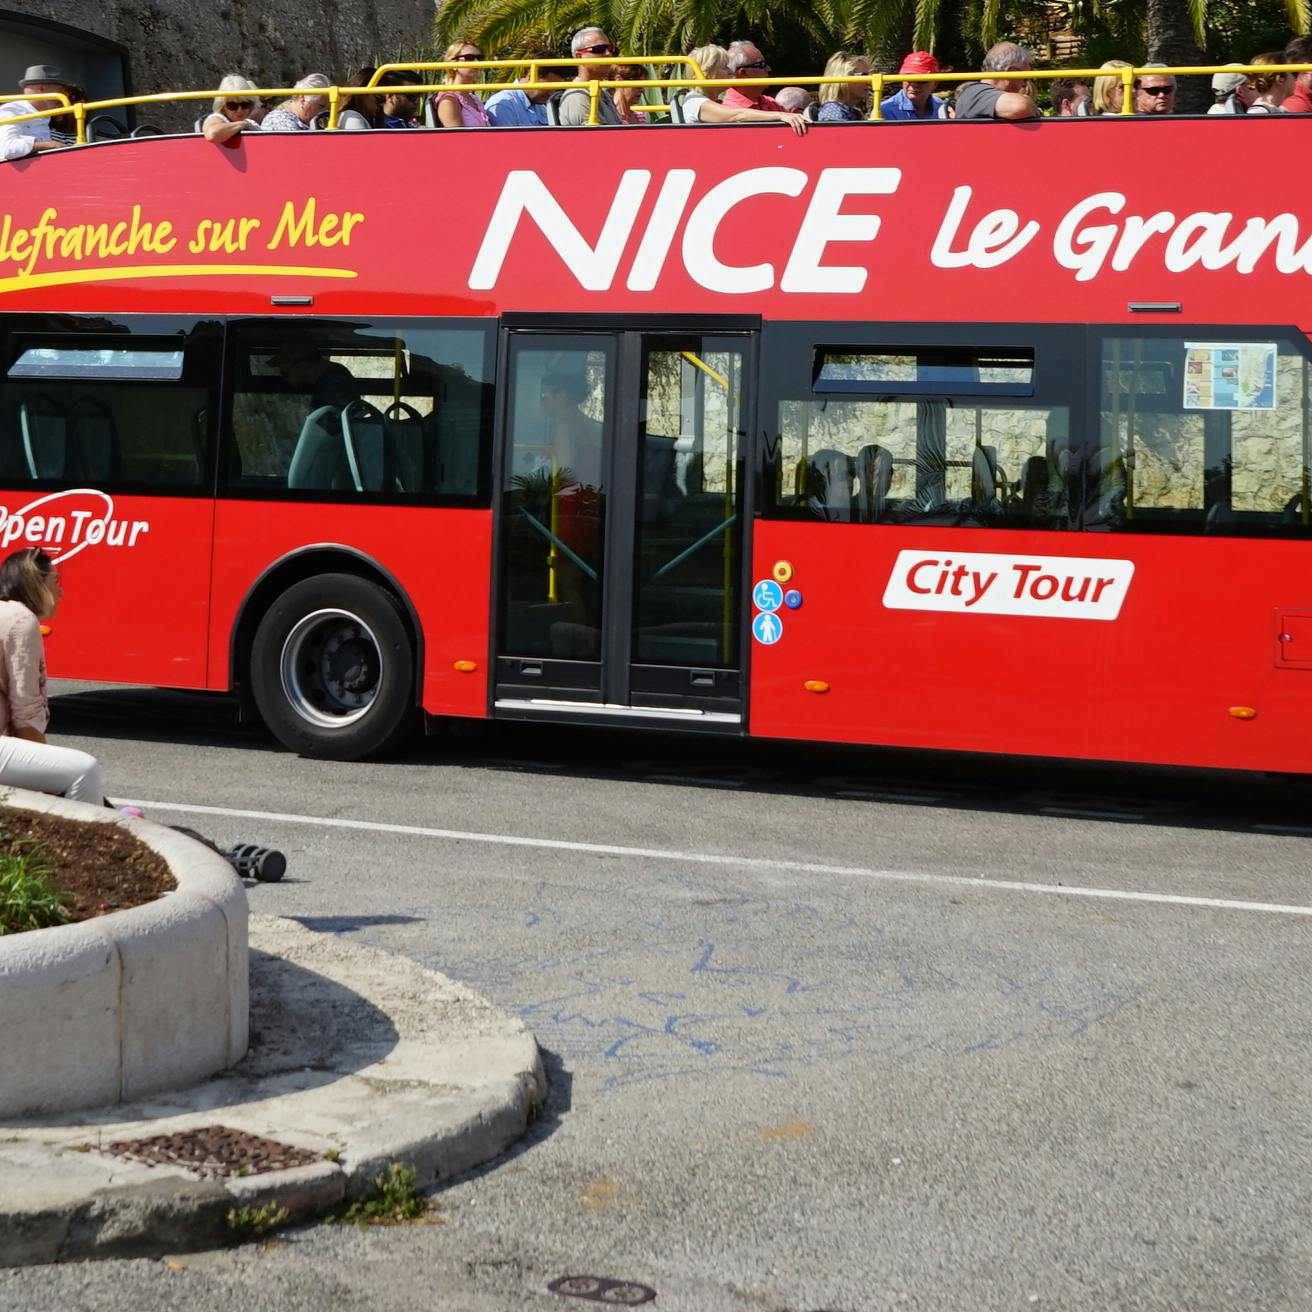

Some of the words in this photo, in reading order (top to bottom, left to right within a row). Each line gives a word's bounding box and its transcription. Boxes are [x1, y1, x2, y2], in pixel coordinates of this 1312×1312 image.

[188, 217, 261, 255] sur
[266, 196, 365, 250] Mer
[468, 167, 902, 294] NICE
[905, 559, 998, 607] City
[1012, 564, 1115, 603] Tour
